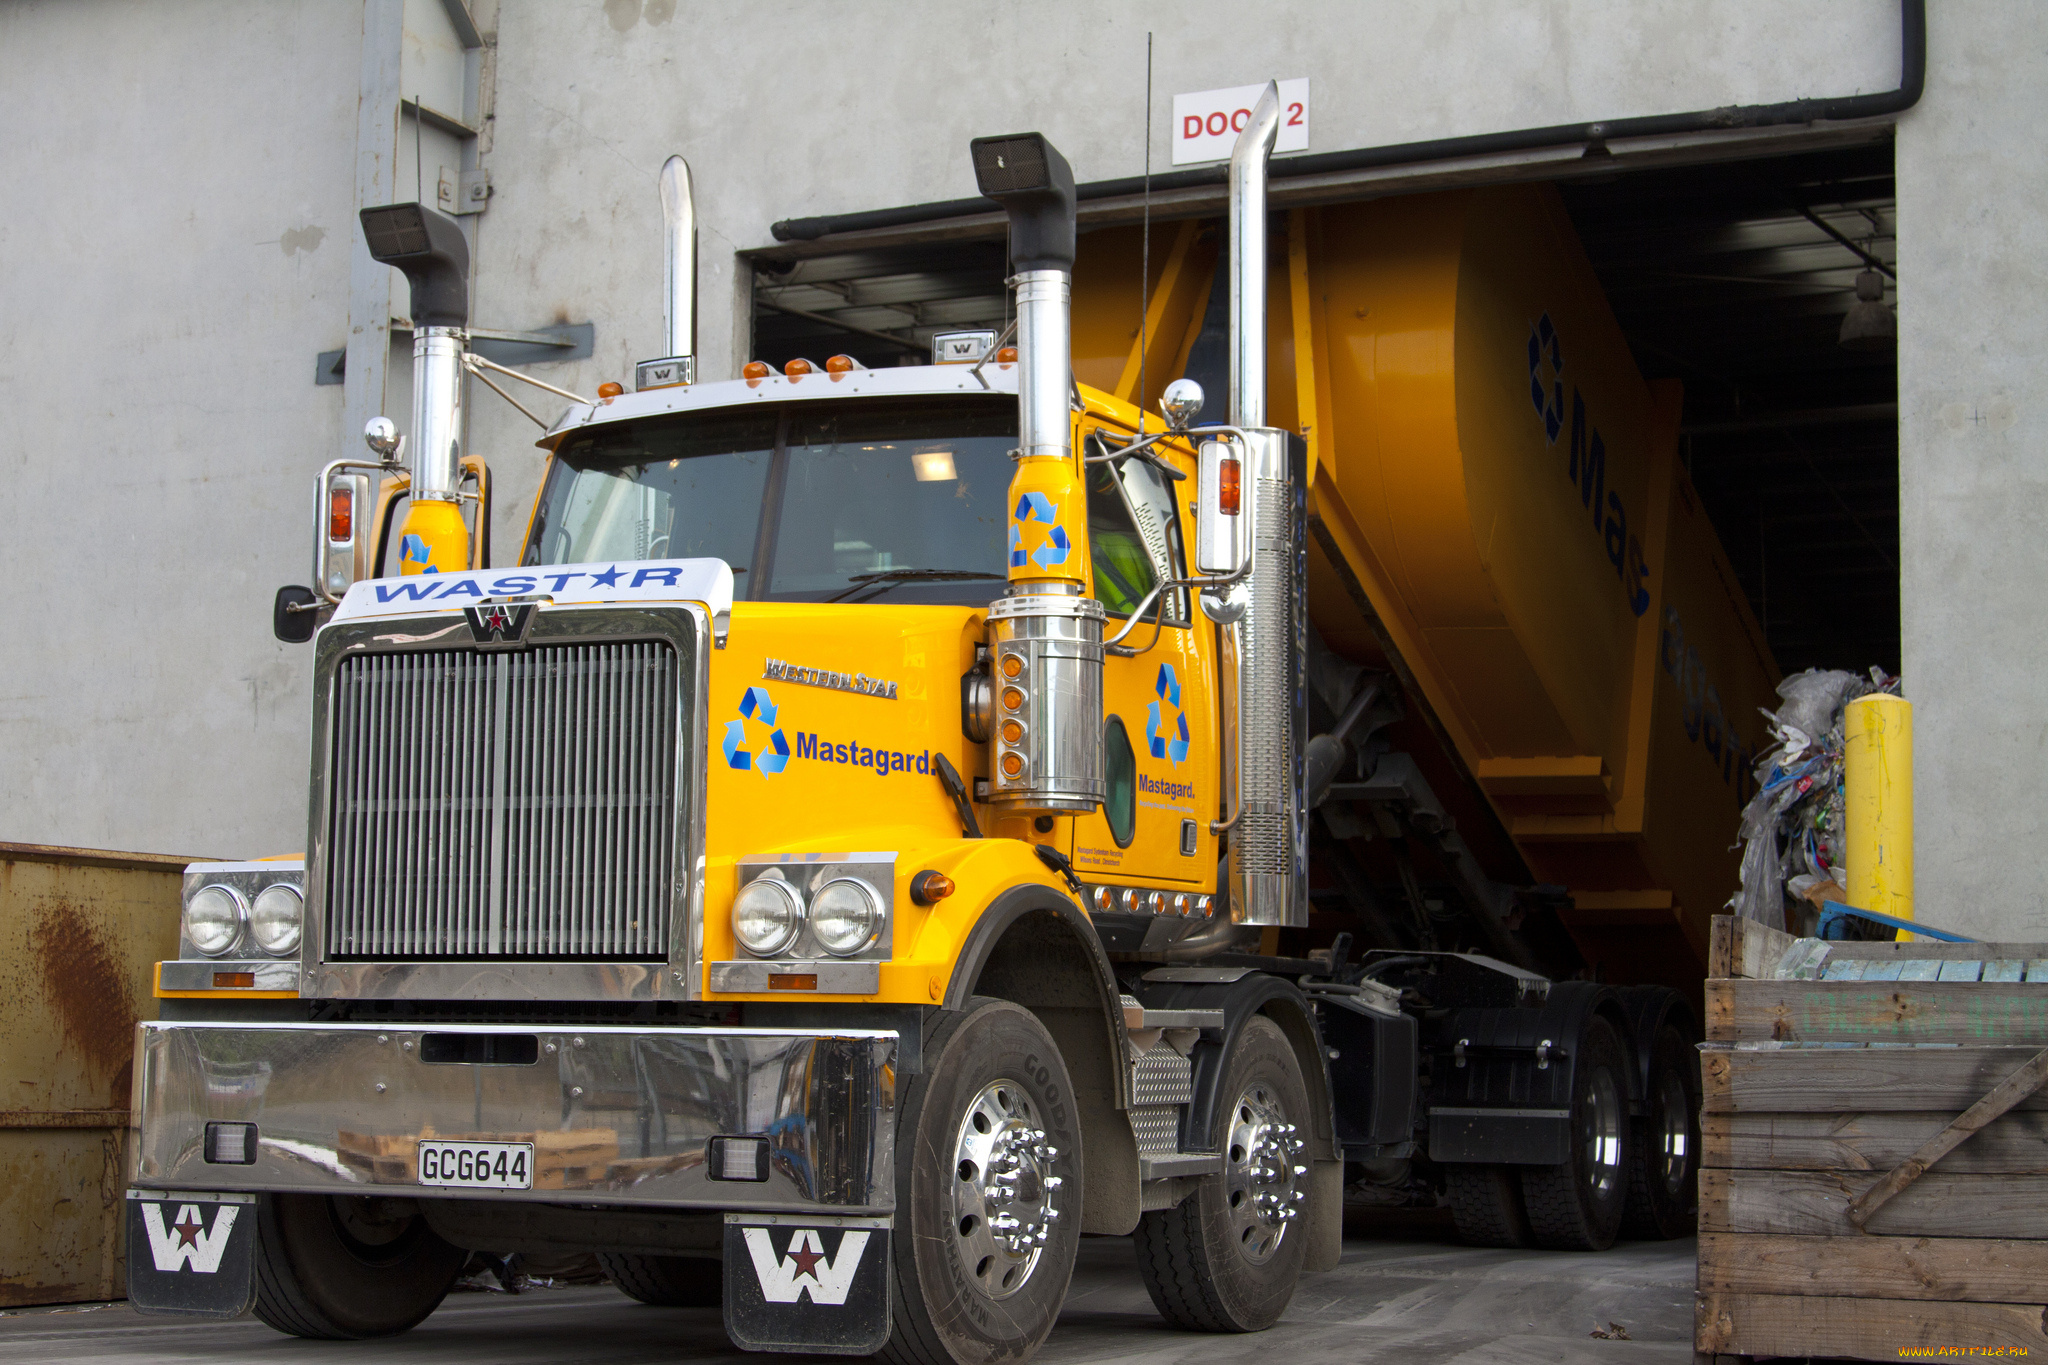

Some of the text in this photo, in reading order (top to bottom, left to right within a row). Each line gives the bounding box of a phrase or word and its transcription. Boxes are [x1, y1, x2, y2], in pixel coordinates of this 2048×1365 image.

[1183, 102, 1304, 140] DOO 2
[796, 731, 936, 776] Mastagard.
[1138, 774, 1195, 800] Mastagard.
[423, 1148, 527, 1182] GCG644
